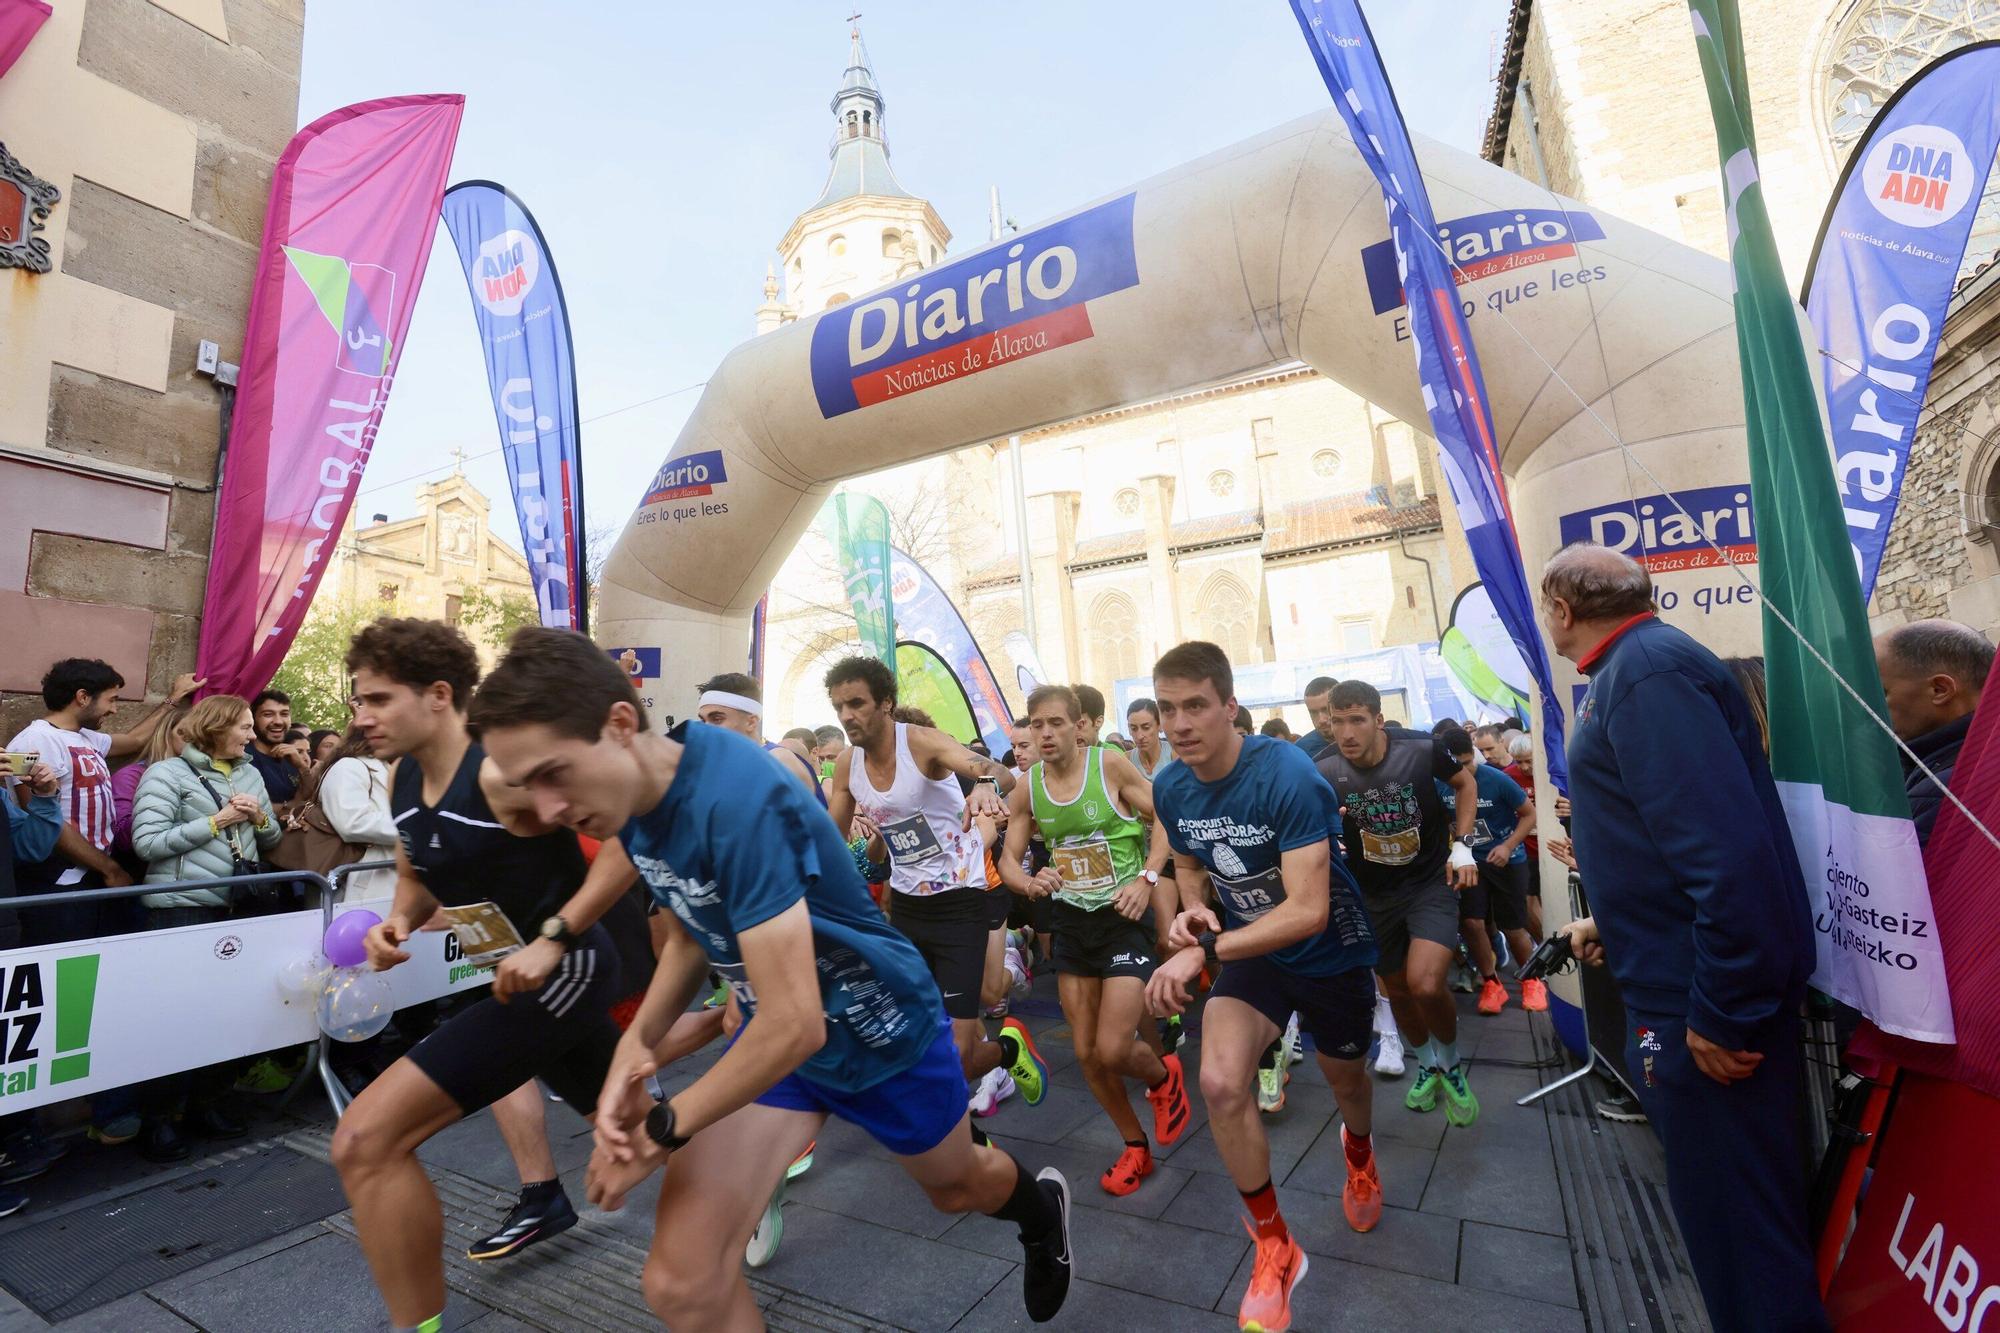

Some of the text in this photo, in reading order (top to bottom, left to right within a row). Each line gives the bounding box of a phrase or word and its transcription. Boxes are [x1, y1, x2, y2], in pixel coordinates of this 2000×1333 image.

[1886, 142, 1953, 182] DNA
[1880, 172, 1951, 212] ADN
[1438, 213, 1568, 265] iario
[1840, 229, 1883, 247] noticias
[1885, 240, 1900, 251] de
[1901, 241, 1934, 260] Álava
[1453, 251, 1546, 285] cias de Álava
[848, 243, 1078, 367] Diario
[1487, 281, 1538, 314] que
[1551, 264, 1606, 292] lees
[884, 329, 1048, 395] Noticias de Álava
[1836, 303, 1931, 585] iario
[648, 459, 709, 494] Diario
[637, 501, 729, 525] Eres lo que lees
[1590, 492, 1752, 553] Diari
[1644, 554, 1684, 572] ticias
[1690, 550, 1709, 567] de
[1693, 584, 1753, 615] que
[890, 829, 921, 851] 983
[1071, 857, 1090, 876] 67
[1231, 888, 1272, 910] 973
